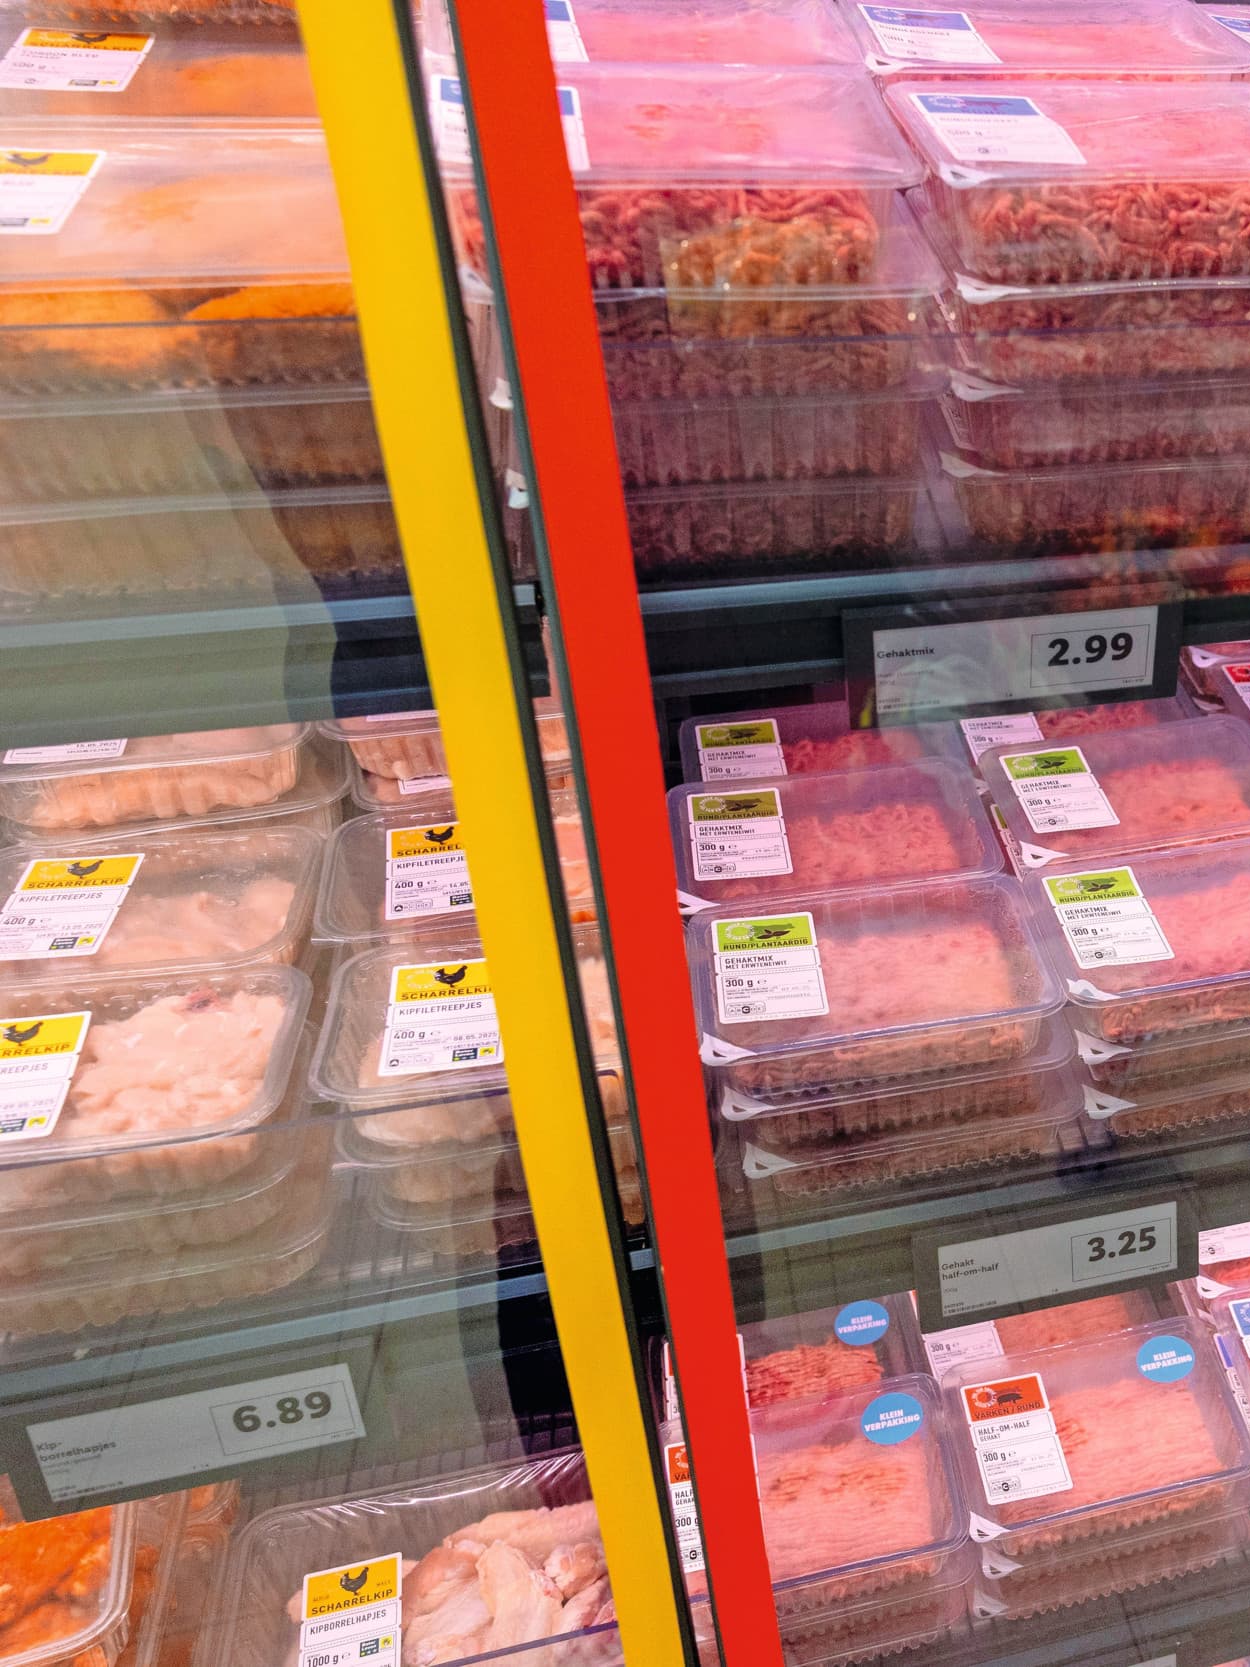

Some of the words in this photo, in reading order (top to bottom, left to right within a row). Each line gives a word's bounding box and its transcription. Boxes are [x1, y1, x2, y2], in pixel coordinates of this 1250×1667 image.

[876, 646, 935, 660] Gehaktmix
[1048, 632, 1133, 667] 2.99
[1020, 779, 1060, 789] GEHAKTMIX
[1026, 799, 1043, 807] 300
[699, 824, 743, 832] GEHAKTMIX
[396, 843, 461, 857] SCHARREL
[699, 843, 717, 851] 300
[396, 855, 464, 869] KIPFILETREEPJE
[26, 877, 124, 889] SCHARRELKIP
[394, 881, 414, 889] 400
[417, 881, 424, 889] g
[18, 891, 104, 903] KIPFILETREEPJES
[1059, 890, 1135, 904] RUND/PLANTAARDIG
[1064, 906, 1108, 916] GEHAKTMIX
[3, 917, 26, 925] 400
[26, 918, 36, 926] g
[1071, 927, 1089, 937] 300
[1091, 928, 1098, 936] g
[723, 938, 809, 951] RUND/PLANTAARDIG
[724, 955, 773, 965] GEHAKTMIX
[741, 960, 787, 969] ERWTENEIWIT
[725, 979, 744, 988] 300
[747, 979, 754, 988] g
[399, 1001, 482, 1016] KIPFILETREEPJES
[393, 1030, 415, 1040] 400
[418, 1031, 425, 1040] g
[1, 1042, 71, 1057] RRELKIP
[1087, 1225, 1157, 1263] 3.25
[941, 1258, 975, 1271] Gehakt
[941, 1262, 1000, 1281] half-om-half
[850, 1315, 873, 1324] KLEIN
[837, 1319, 887, 1334] VERPAKKING
[1152, 1350, 1177, 1361] KLEIN
[1140, 1354, 1193, 1372] VERPAKKING
[231, 1389, 332, 1434] 6.89
[879, 1409, 904, 1421] KLEIN
[974, 1407, 1009, 1419] VARKEN
[1016, 1401, 1041, 1412] RUND
[864, 1413, 920, 1432] VERPAKKING
[977, 1420, 1031, 1436] HALF-OM-HALF
[980, 1433, 1001, 1442] GEHAKT
[38, 1439, 117, 1463] borrelhapjes
[983, 1452, 999, 1463] 300
[1000, 1452, 1007, 1461] g
[675, 1489, 694, 1499] HALF
[675, 1516, 692, 1528] 300
[311, 1588, 393, 1615] SCHARRELKIP
[310, 1609, 387, 1635] KIPBORRELHAPJES
[307, 1654, 330, 1667] 1000
[332, 1654, 339, 1664] g
